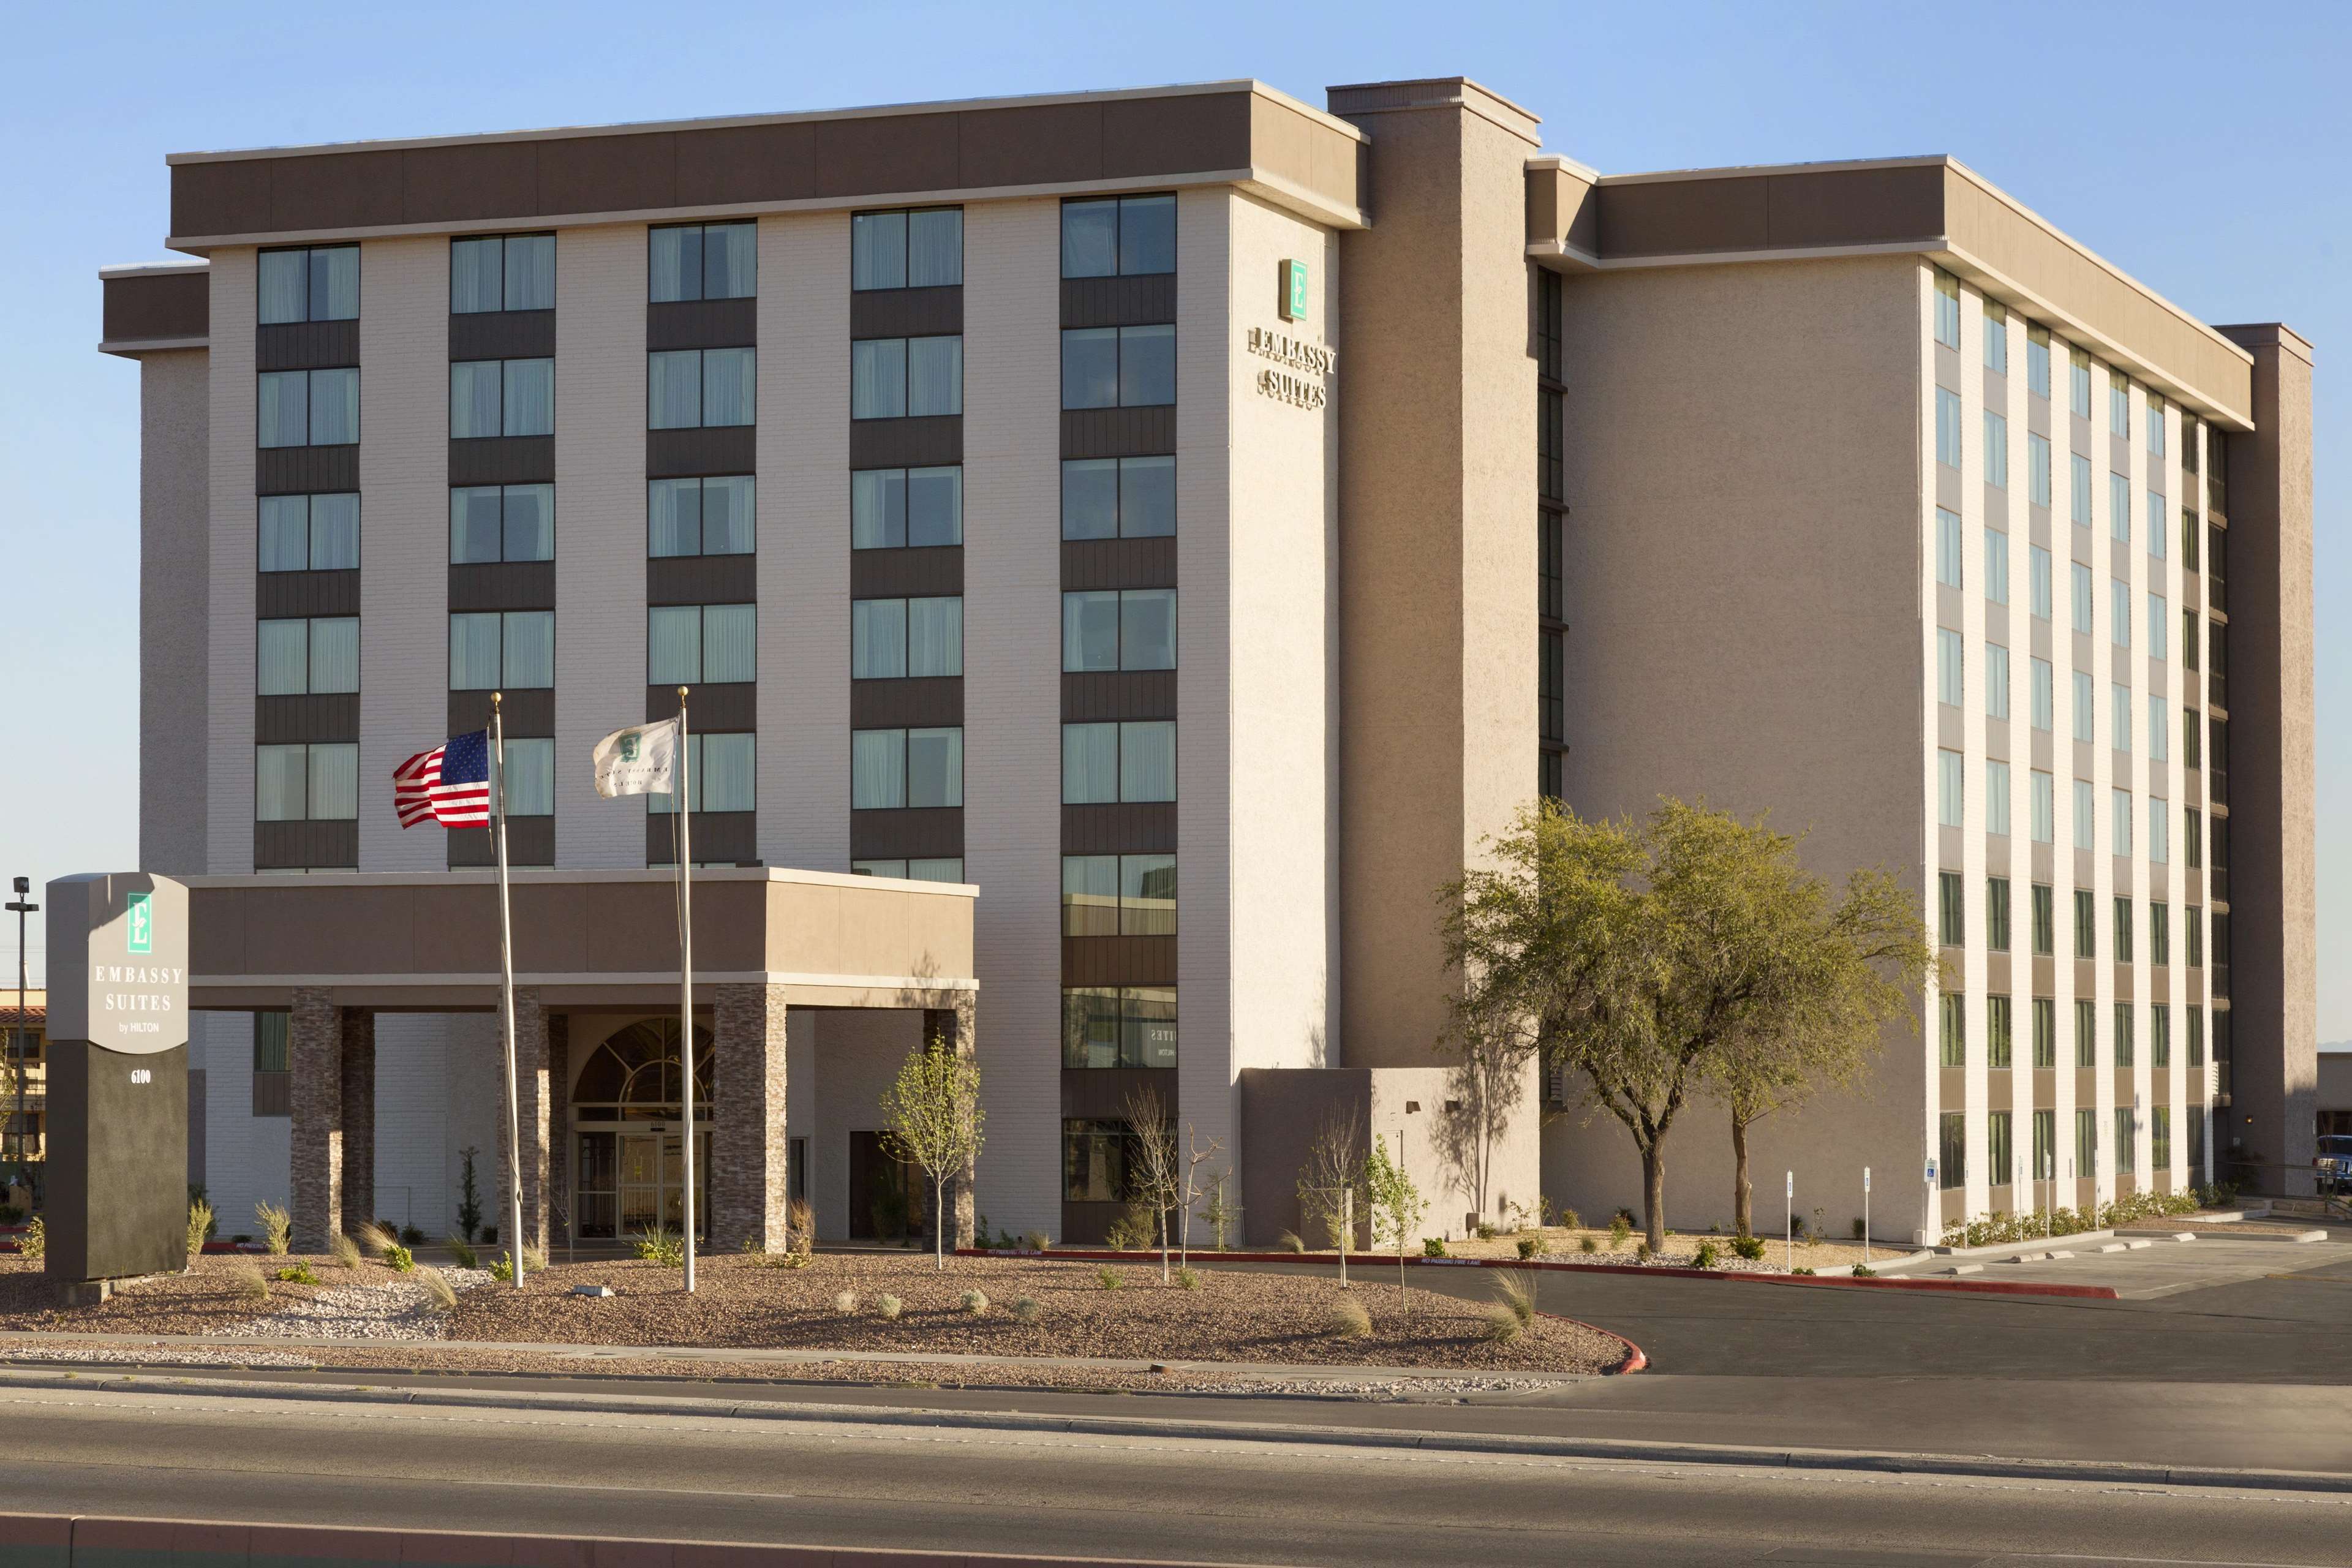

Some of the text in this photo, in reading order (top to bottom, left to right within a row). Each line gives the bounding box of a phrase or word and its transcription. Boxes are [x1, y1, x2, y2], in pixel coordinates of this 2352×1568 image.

[1259, 327, 1336, 374] EMBASSY
[1268, 368, 1327, 409] SUITES
[95, 965, 183, 984] EMBASSY
[105, 993, 171, 1011] SUITES
[119, 1022, 159, 1035] by HILTON
[131, 1069, 151, 1085] 6100
